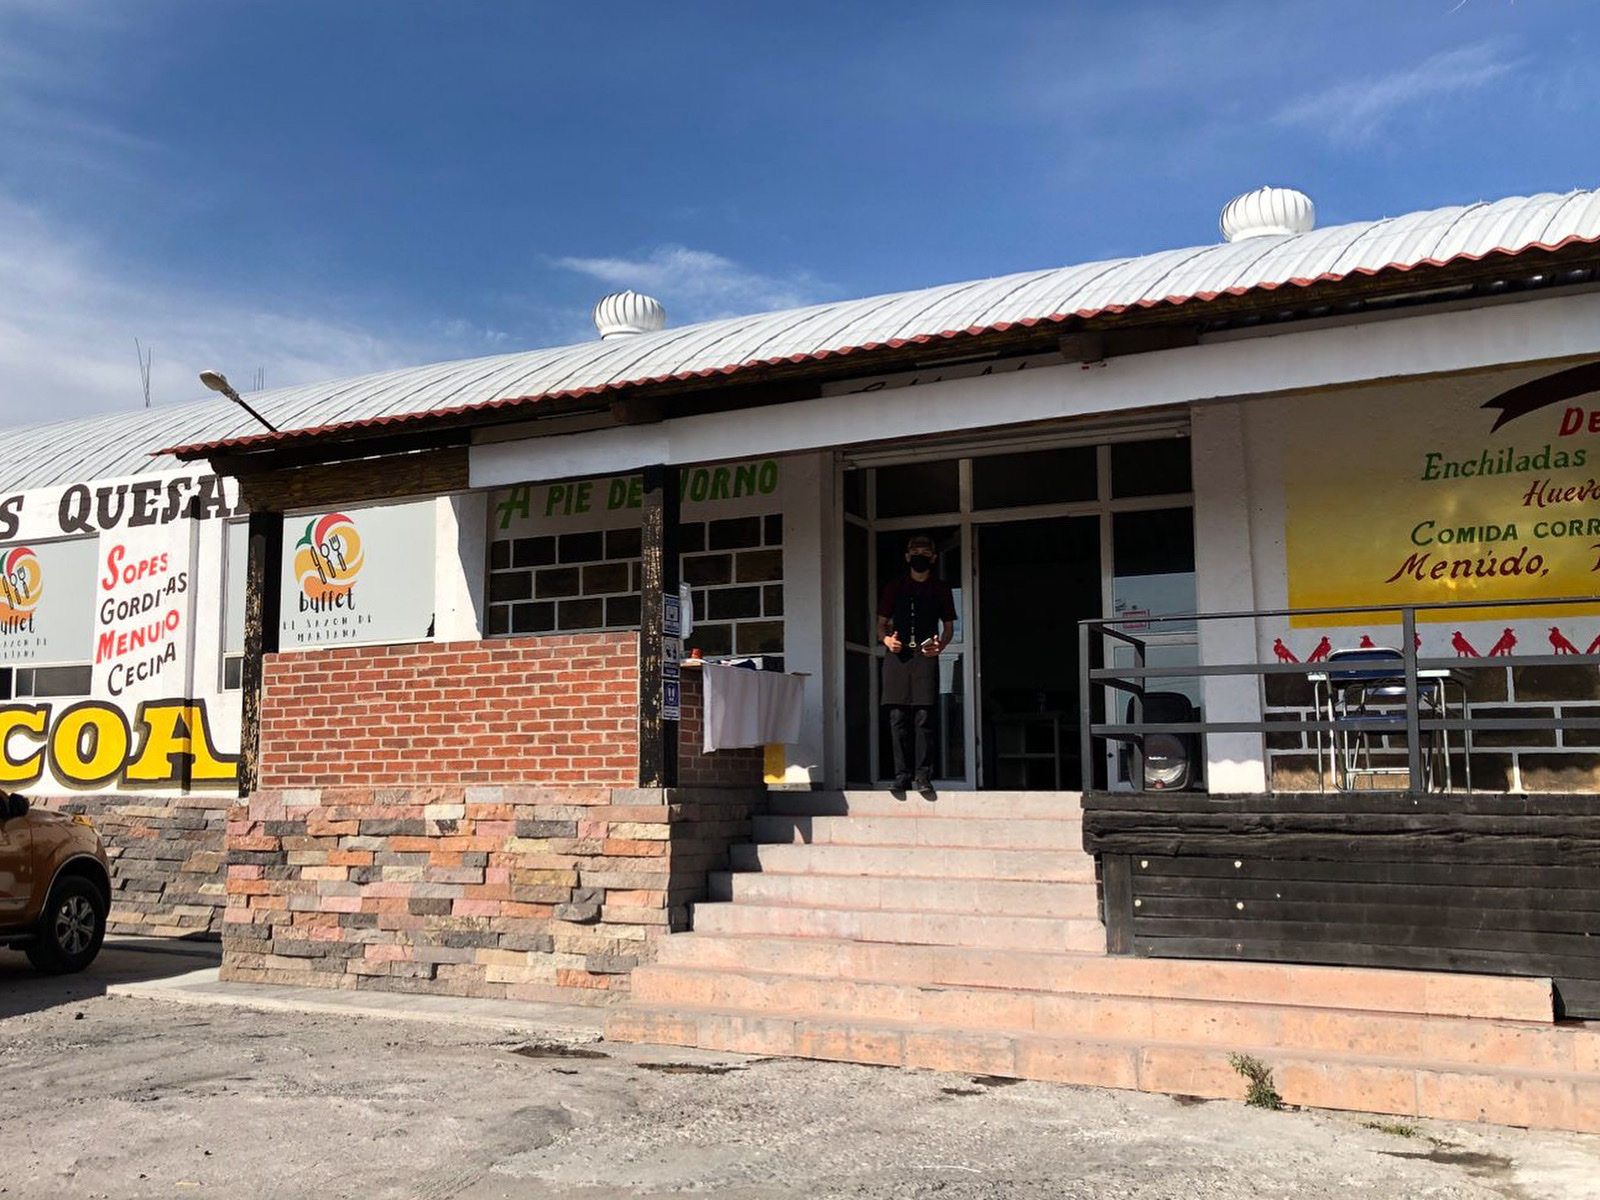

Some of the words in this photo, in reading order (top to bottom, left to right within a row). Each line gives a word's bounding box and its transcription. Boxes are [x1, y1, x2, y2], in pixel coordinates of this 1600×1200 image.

[1421, 445, 1587, 481] Enchiladas
[495, 486, 530, 529] A
[546, 481, 593, 517] PIE
[607, 474, 644, 511] DE
[1411, 520, 1518, 546] COMIDA
[102, 545, 168, 591] SOPES
[100, 571, 187, 625] GORDIAS
[299, 587, 356, 613] buffet
[96, 609, 179, 664] MENUO
